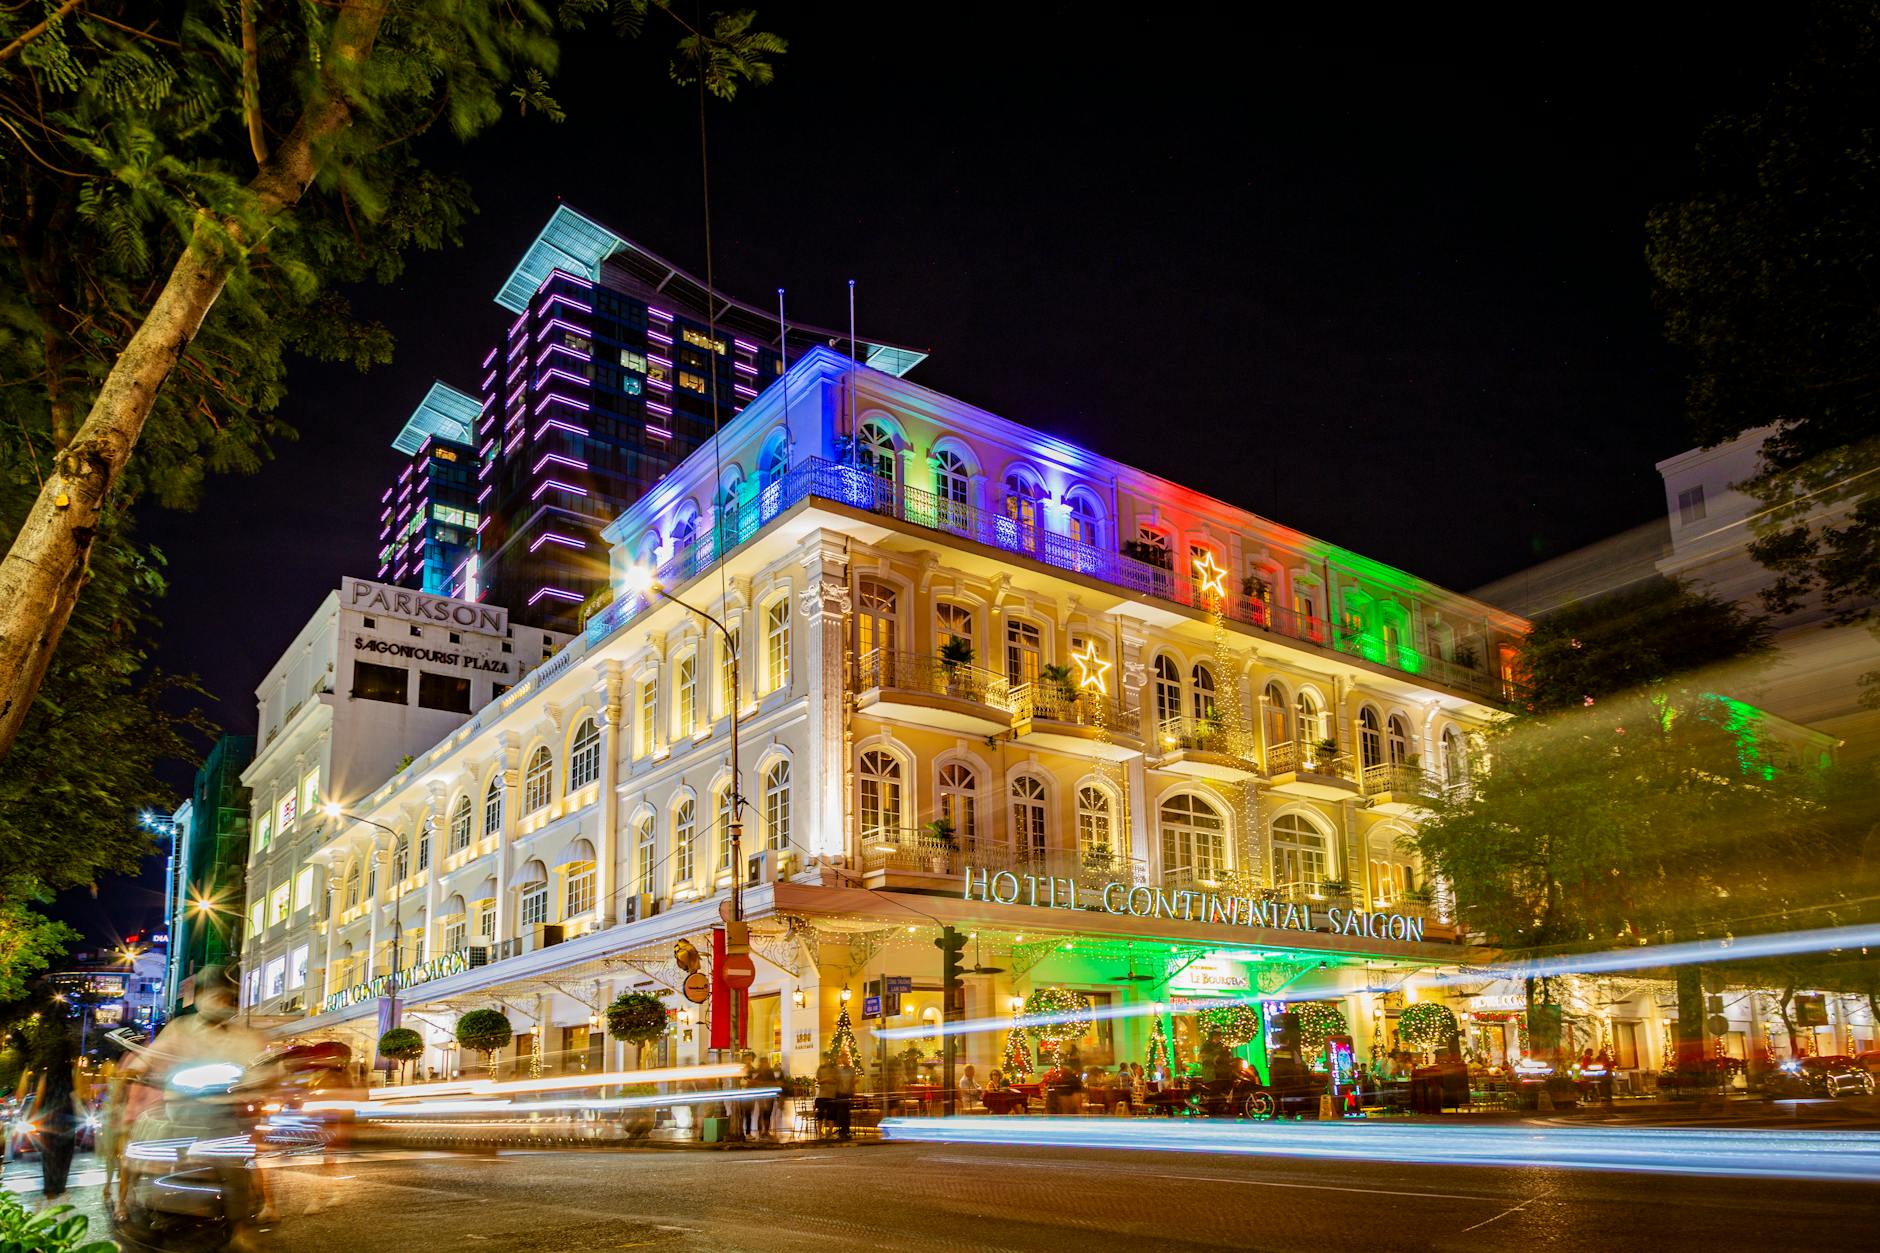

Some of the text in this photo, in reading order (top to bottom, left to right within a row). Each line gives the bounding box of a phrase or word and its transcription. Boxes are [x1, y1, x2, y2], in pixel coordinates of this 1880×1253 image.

[352, 582, 500, 632] PARKSON
[354, 637, 509, 674] SAIGONTOURIST PLAZA
[964, 866, 1424, 943] HOTEL CONTINENTAL SAIGON
[423, 947, 470, 983] SAIGON
